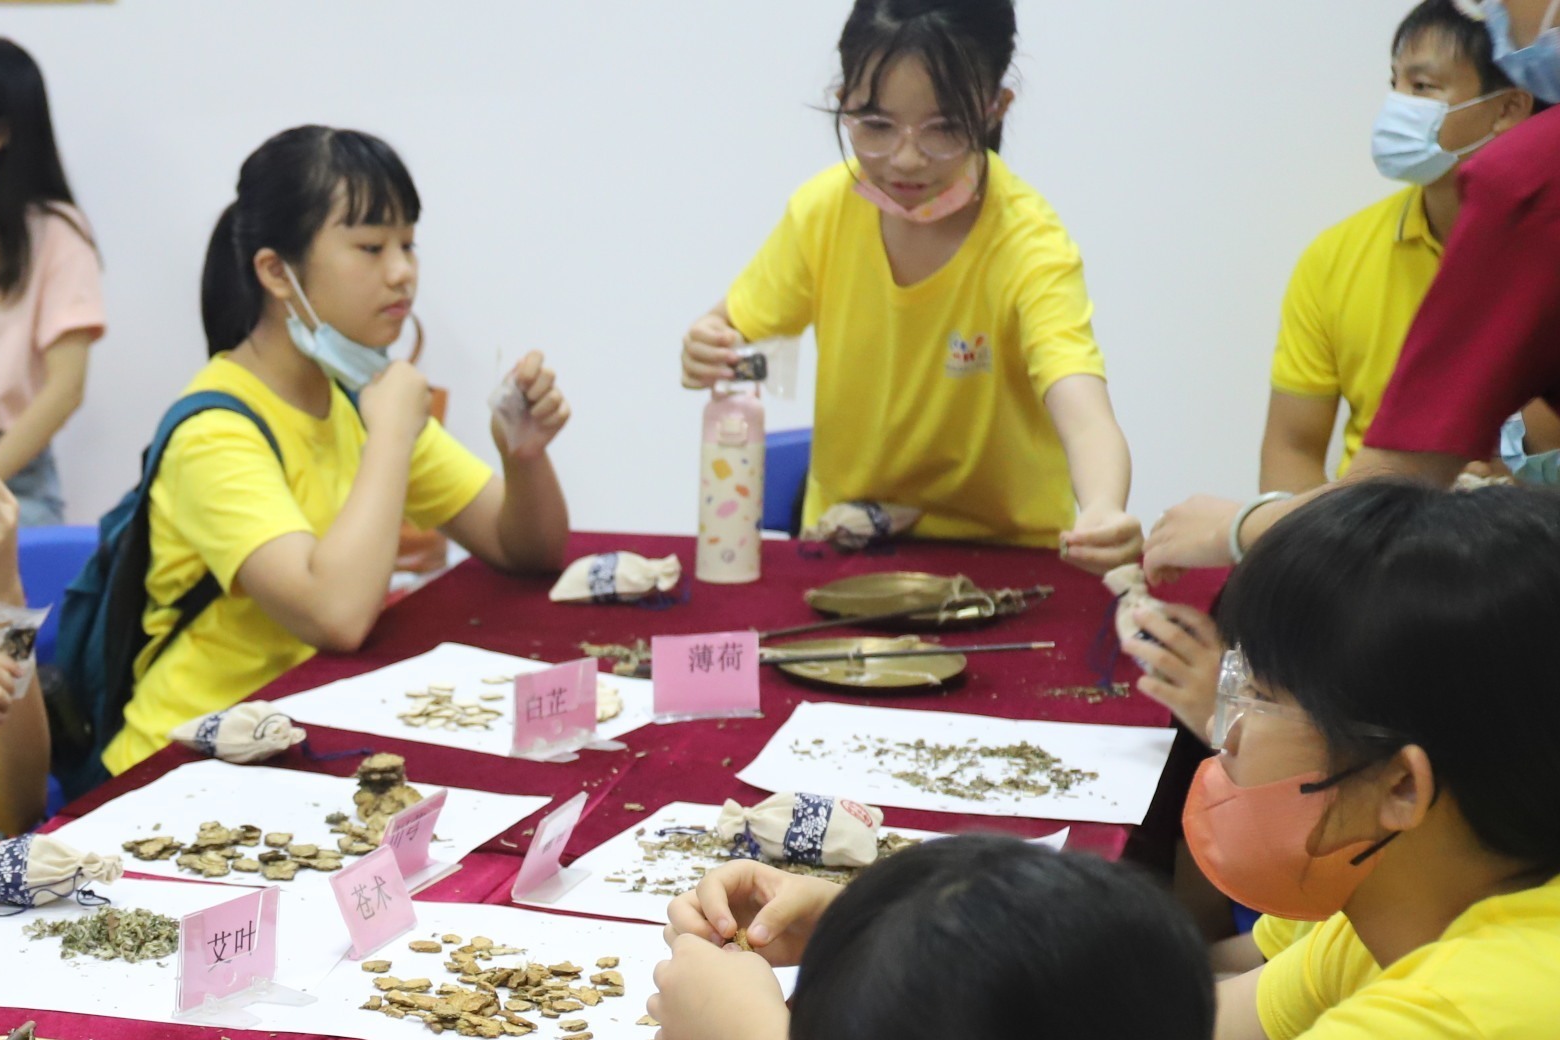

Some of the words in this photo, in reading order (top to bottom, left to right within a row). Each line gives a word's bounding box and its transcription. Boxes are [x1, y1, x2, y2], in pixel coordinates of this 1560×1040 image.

[688, 642, 744, 674] 薄荷
[525, 688, 568, 723] 白芷
[351, 875, 393, 921] 苍术
[206, 920, 257, 973] 艾叶
